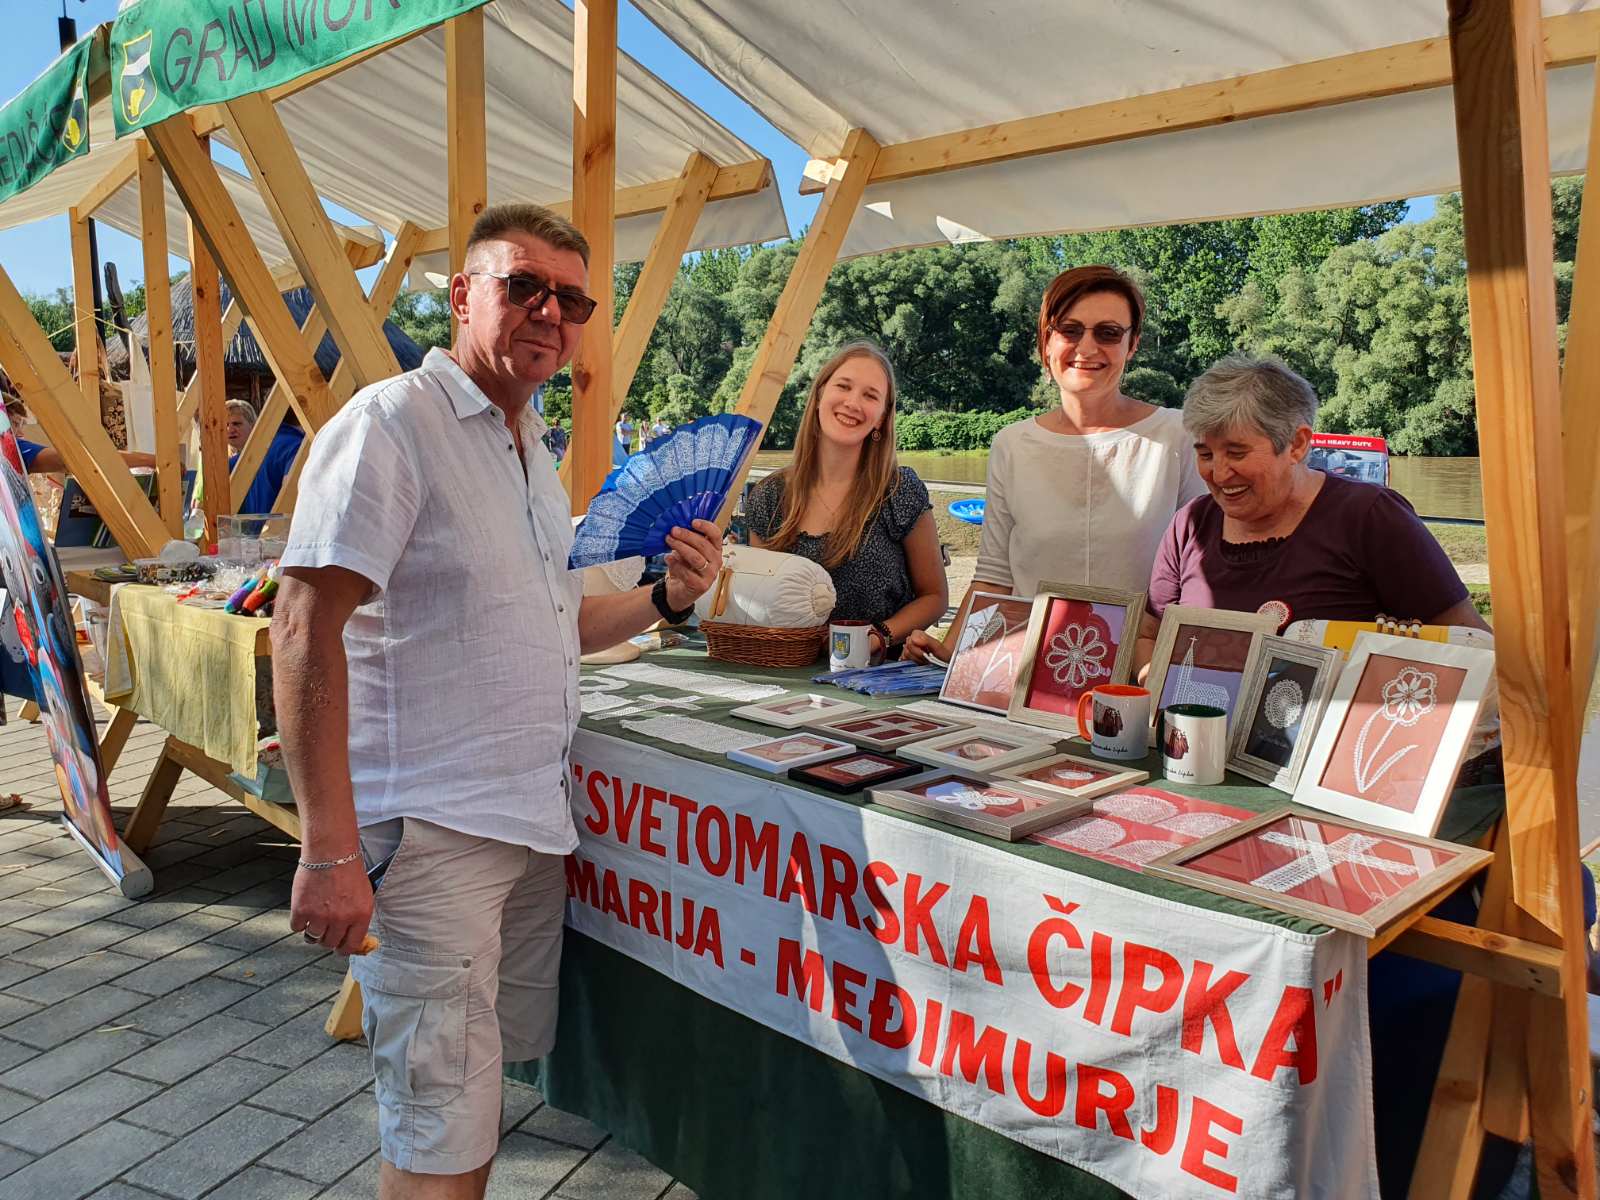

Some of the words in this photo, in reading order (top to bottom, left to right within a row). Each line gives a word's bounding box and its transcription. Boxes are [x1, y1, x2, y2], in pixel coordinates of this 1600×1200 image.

[164, 0, 276, 93] GRAD
[564, 853, 725, 970] MARIJA
[775, 936, 1243, 1194] MEĐIMURJE
[1026, 893, 1343, 1086] ČIPKA"
